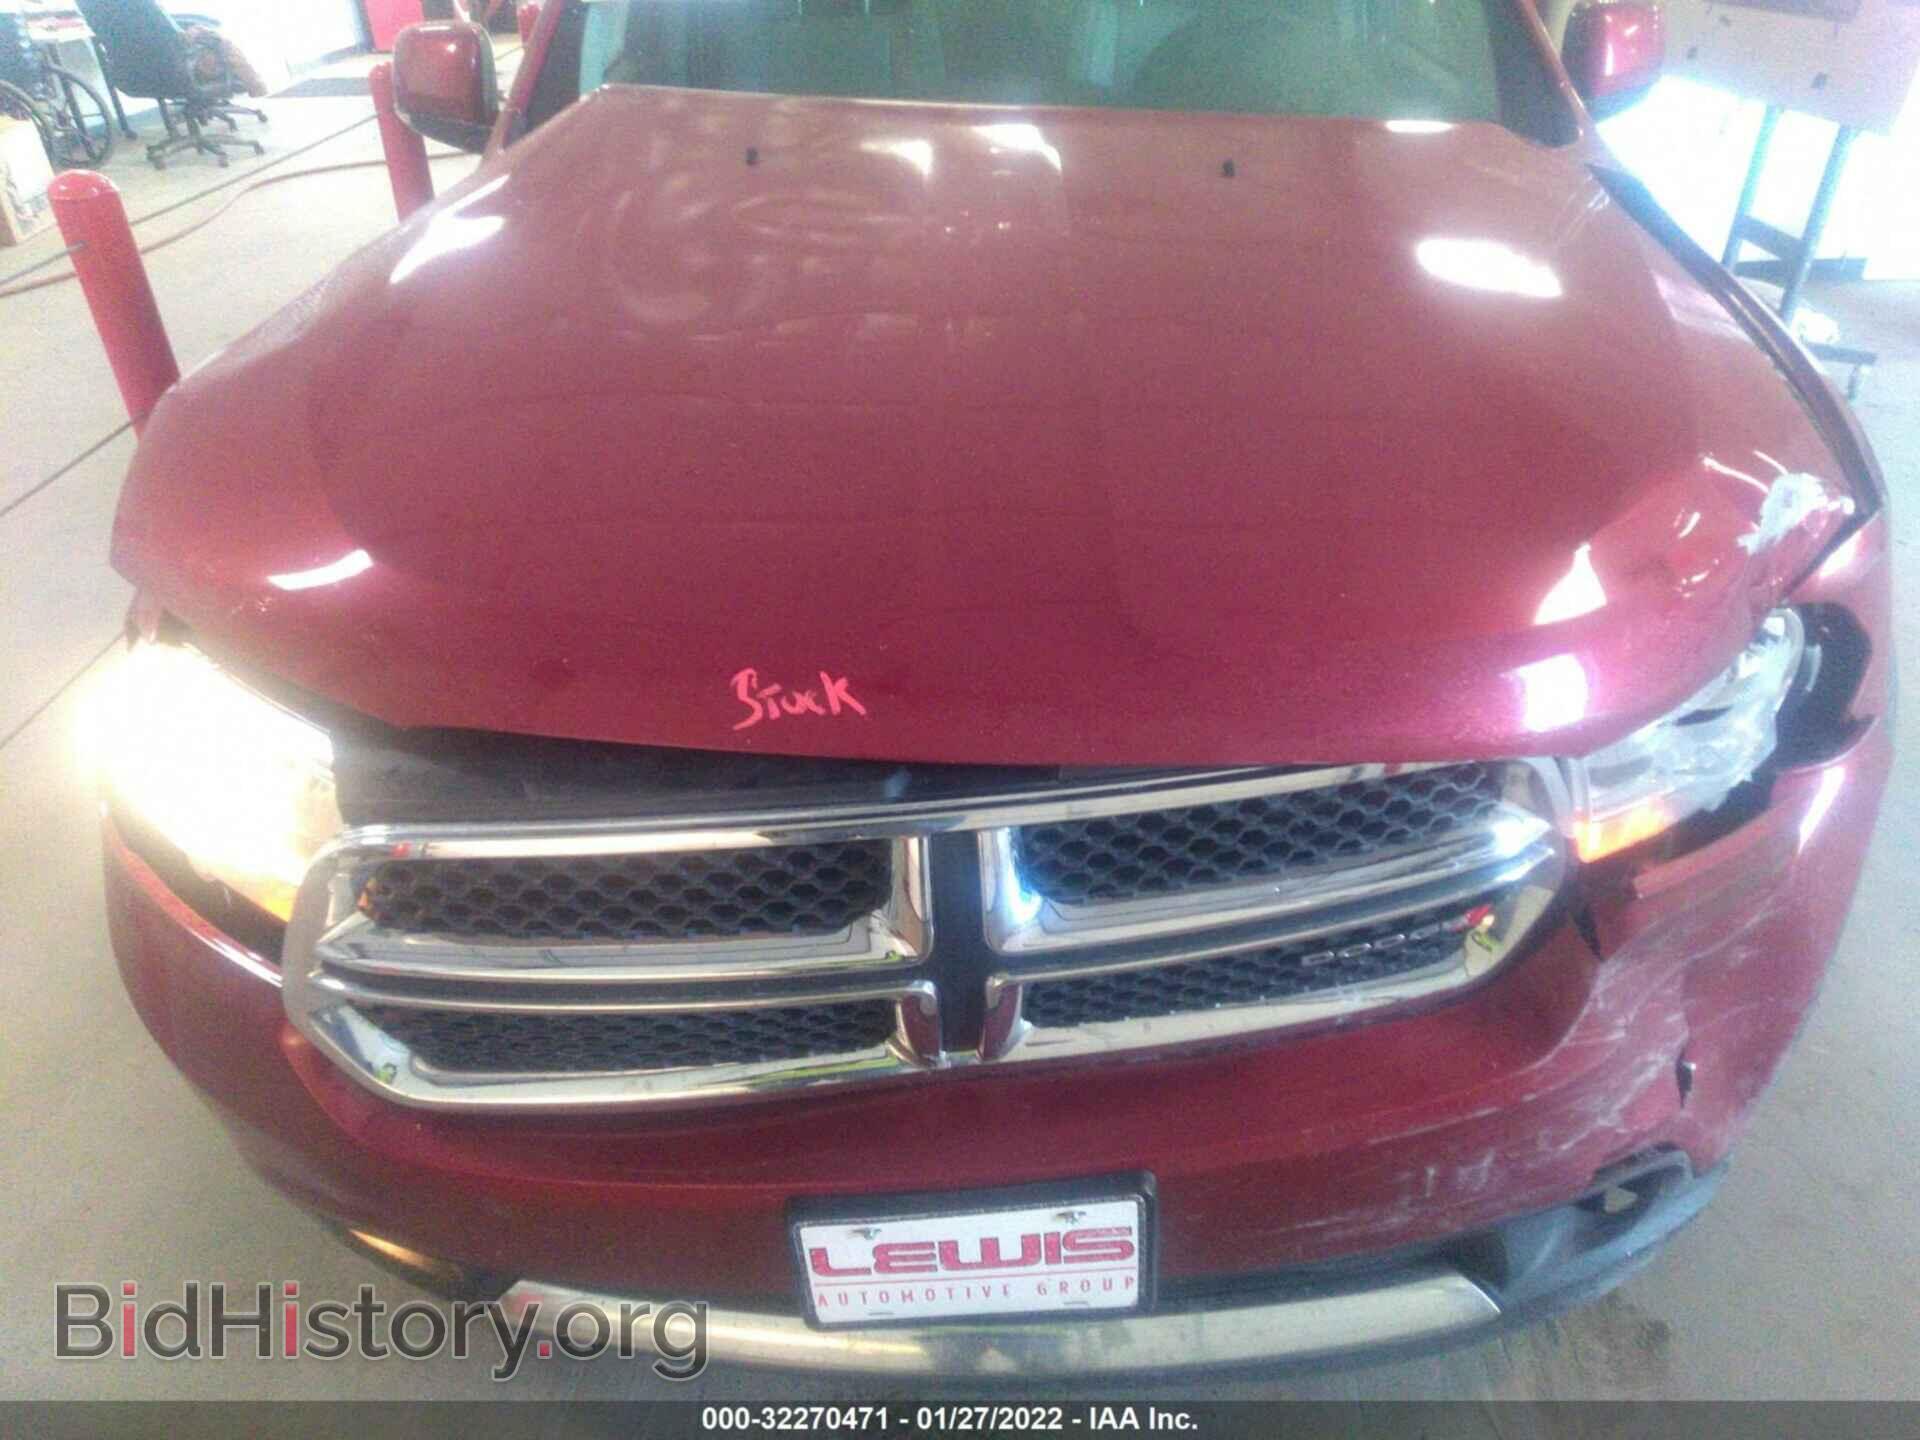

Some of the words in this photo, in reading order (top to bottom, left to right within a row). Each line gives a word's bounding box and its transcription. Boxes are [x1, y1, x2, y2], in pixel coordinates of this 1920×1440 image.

[809, 1226, 1136, 1277] LEWIS
[817, 1284, 1012, 1307] AUTOMOTIVE
[1036, 1276, 1135, 1296] GROUP
